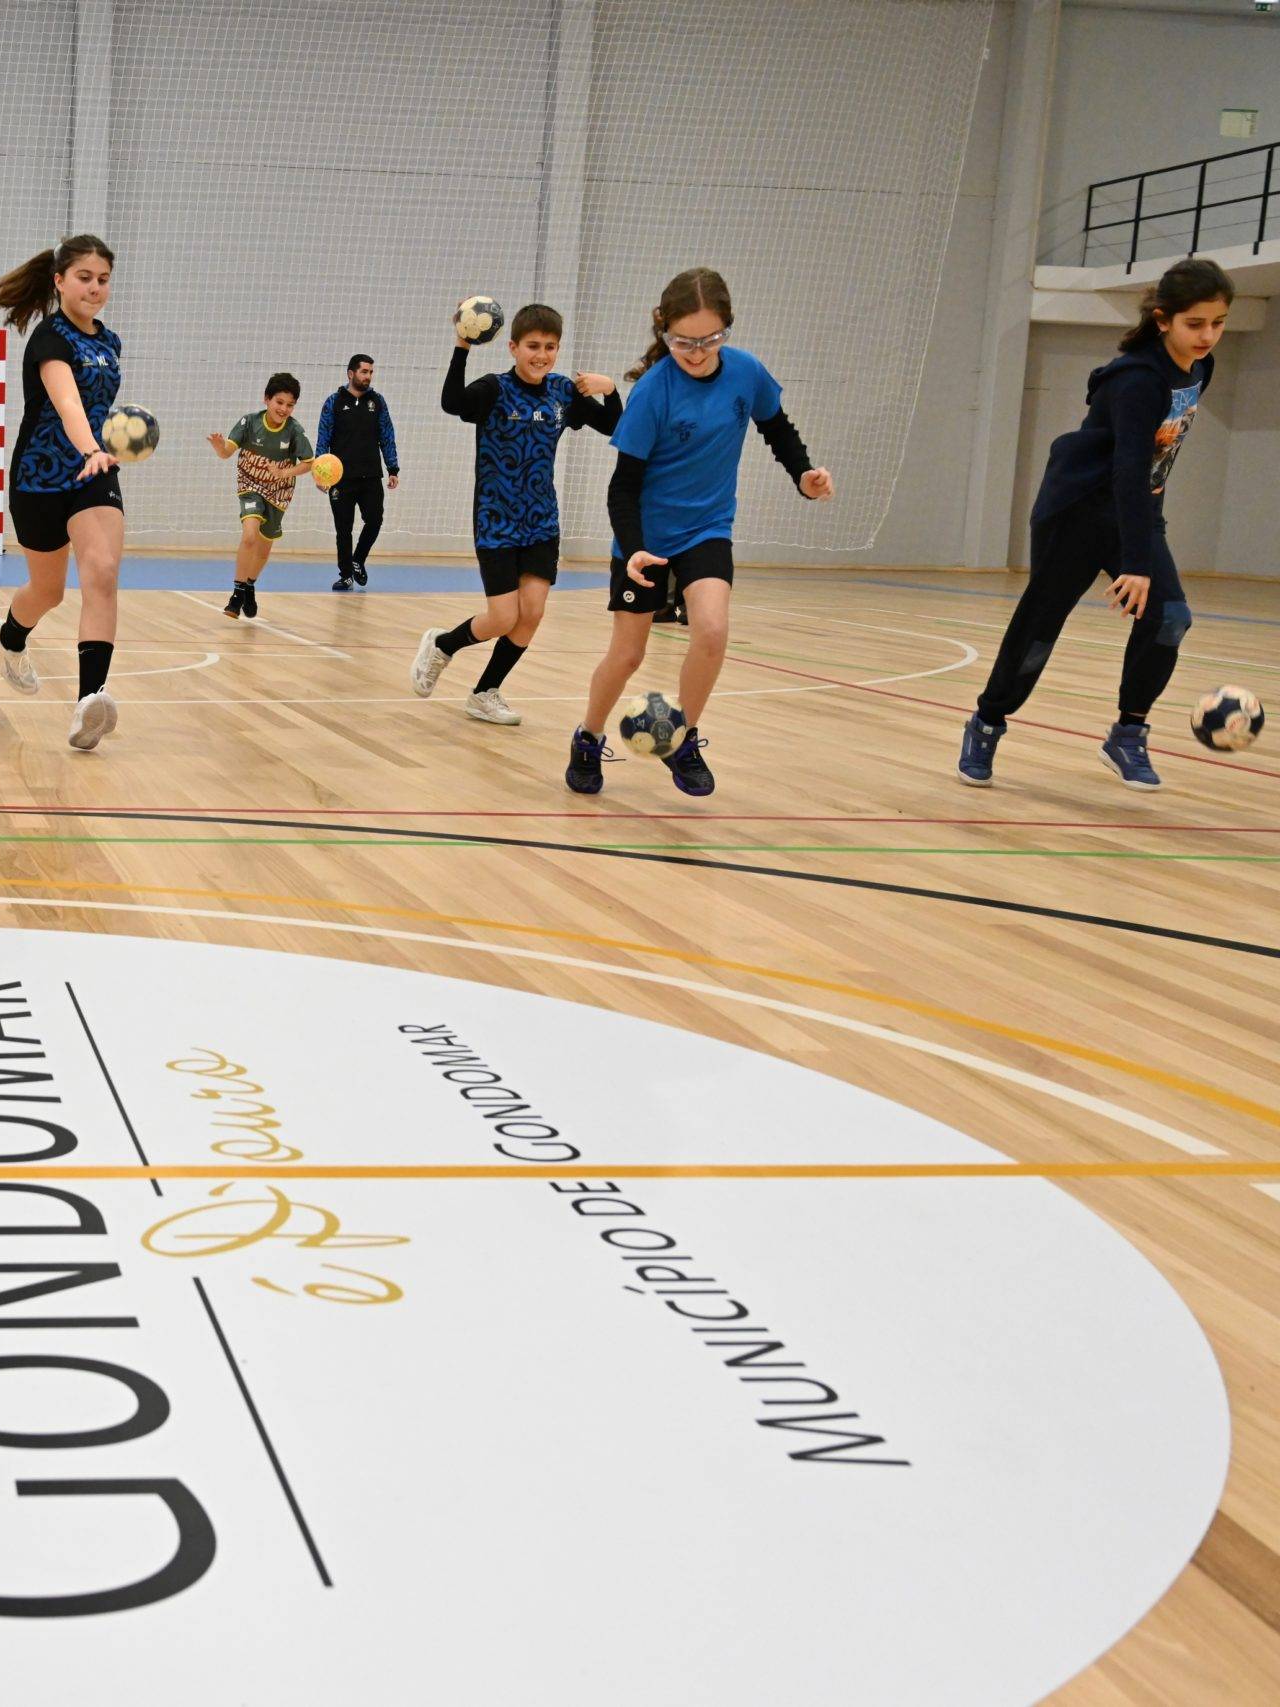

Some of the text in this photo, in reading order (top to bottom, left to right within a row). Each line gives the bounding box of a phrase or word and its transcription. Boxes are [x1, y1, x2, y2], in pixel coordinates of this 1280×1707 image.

[397, 1024, 911, 1466] MUNICÍPIO DE GONDOMAR
